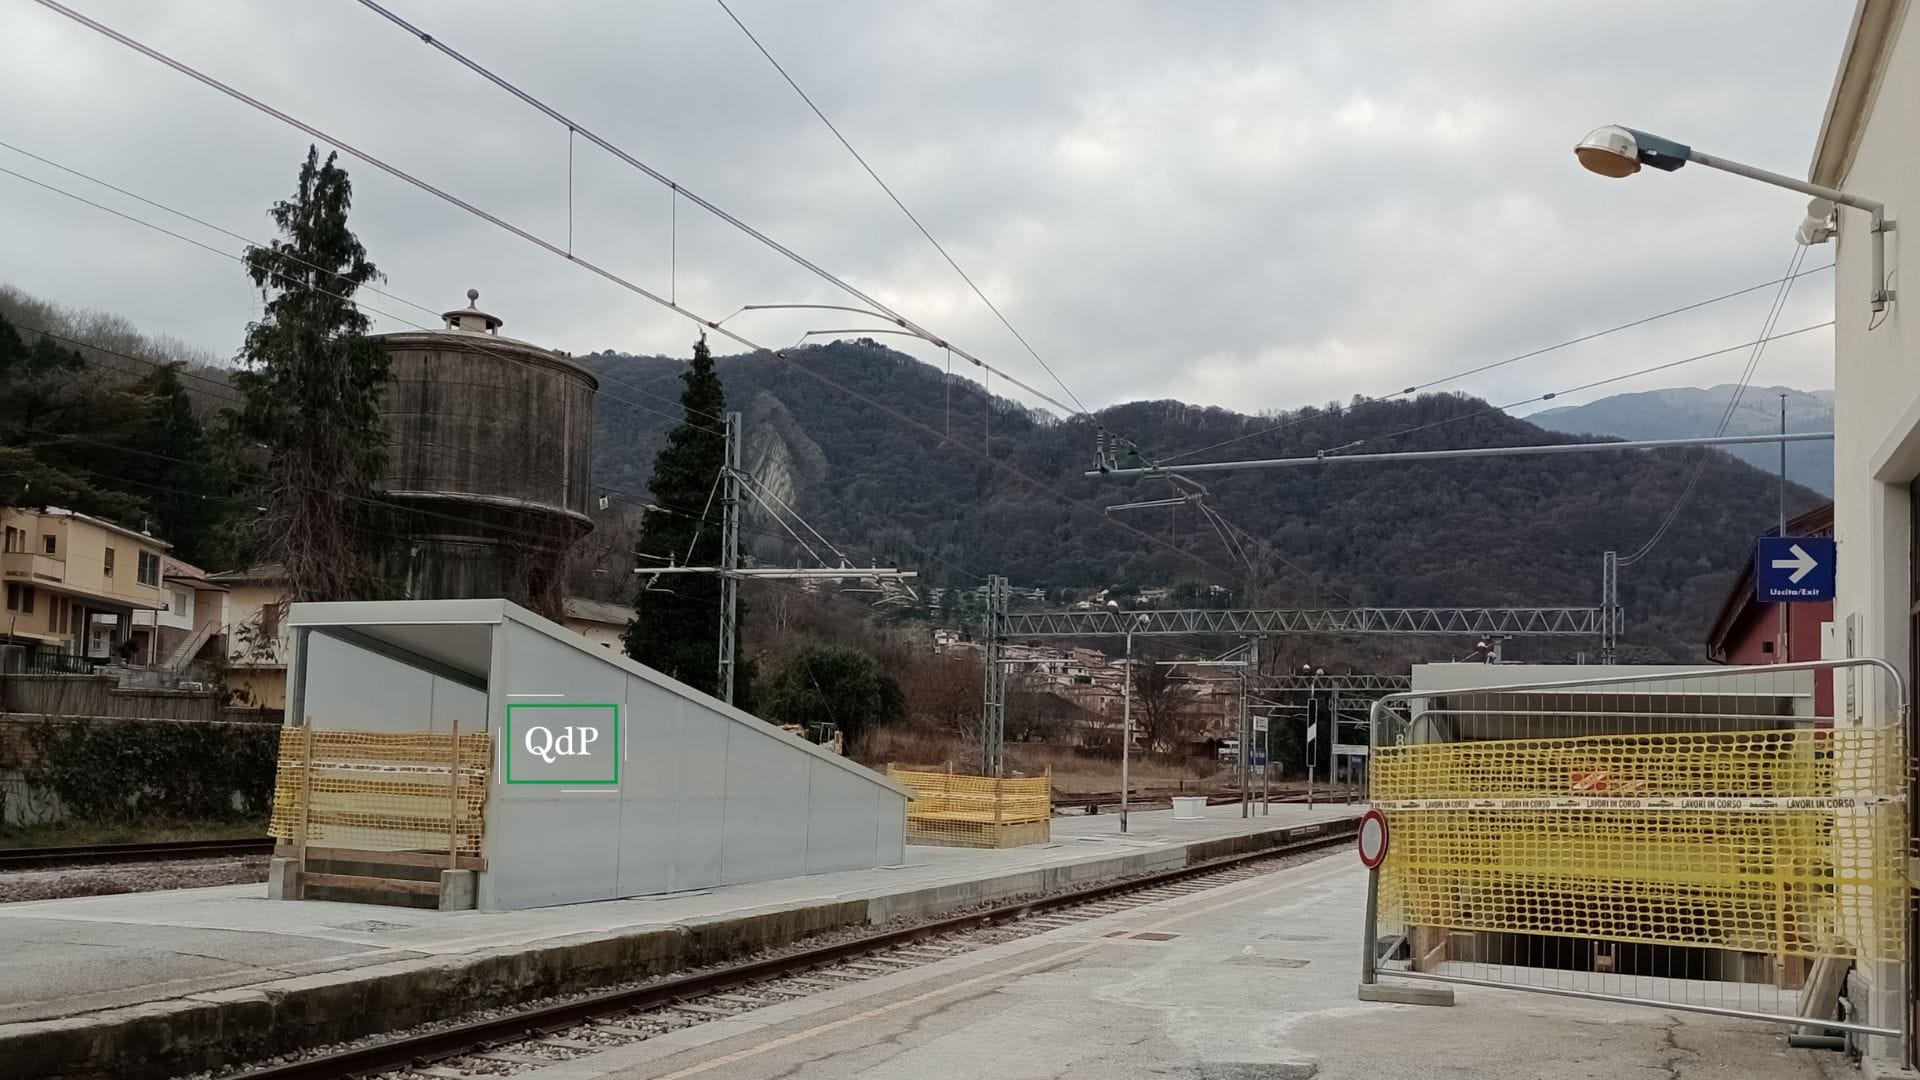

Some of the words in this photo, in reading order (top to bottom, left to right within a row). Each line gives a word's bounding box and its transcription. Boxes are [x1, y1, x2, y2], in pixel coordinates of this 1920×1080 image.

[1769, 588, 1820, 596] Uscita/Exit
[1501, 800, 1522, 808] LAVORI
[1523, 800, 1529, 808] IN
[1530, 800, 1551, 808] CORSO
[1586, 800, 1609, 808] LAVORI
[1610, 800, 1618, 808] IN
[1618, 799, 1641, 808] CORSO
[1681, 800, 1706, 808] LAVORI
[1707, 800, 1715, 808] IN
[1717, 799, 1742, 808] CORSO
[1786, 799, 1814, 809] LAVORI
[1816, 799, 1824, 809] IN
[1826, 798, 1855, 808] CORSO
